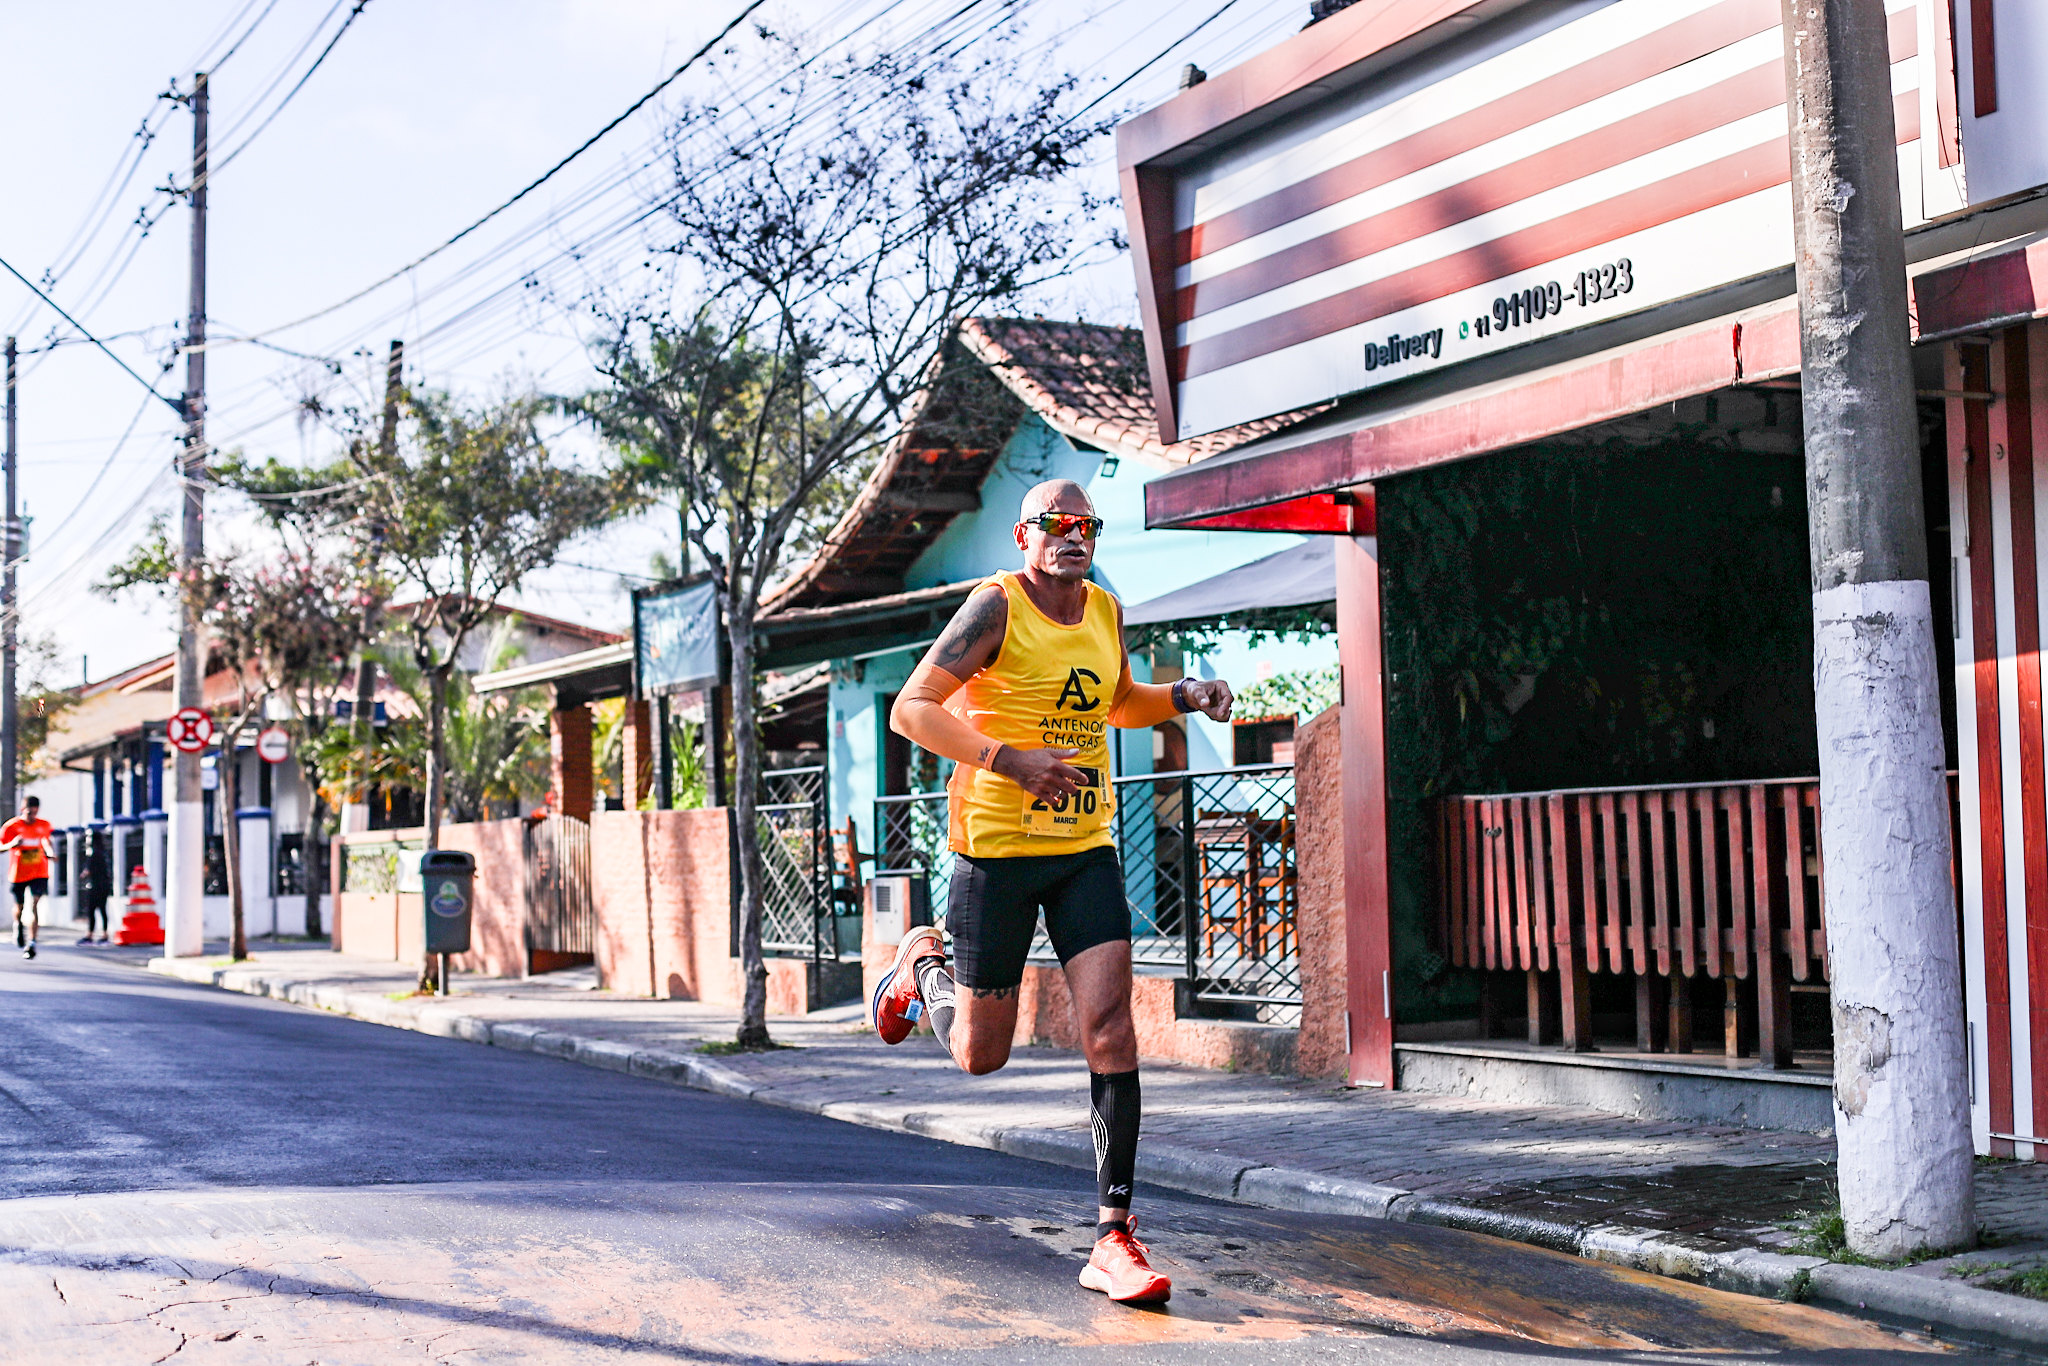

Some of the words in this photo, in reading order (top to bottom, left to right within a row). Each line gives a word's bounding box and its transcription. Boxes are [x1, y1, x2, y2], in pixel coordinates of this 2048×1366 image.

[1365, 328, 1443, 371] Delivery
[1474, 315, 1490, 338] 11
[1493, 257, 1634, 332] 91109-1323
[1042, 731, 1100, 748] CHAGAS
